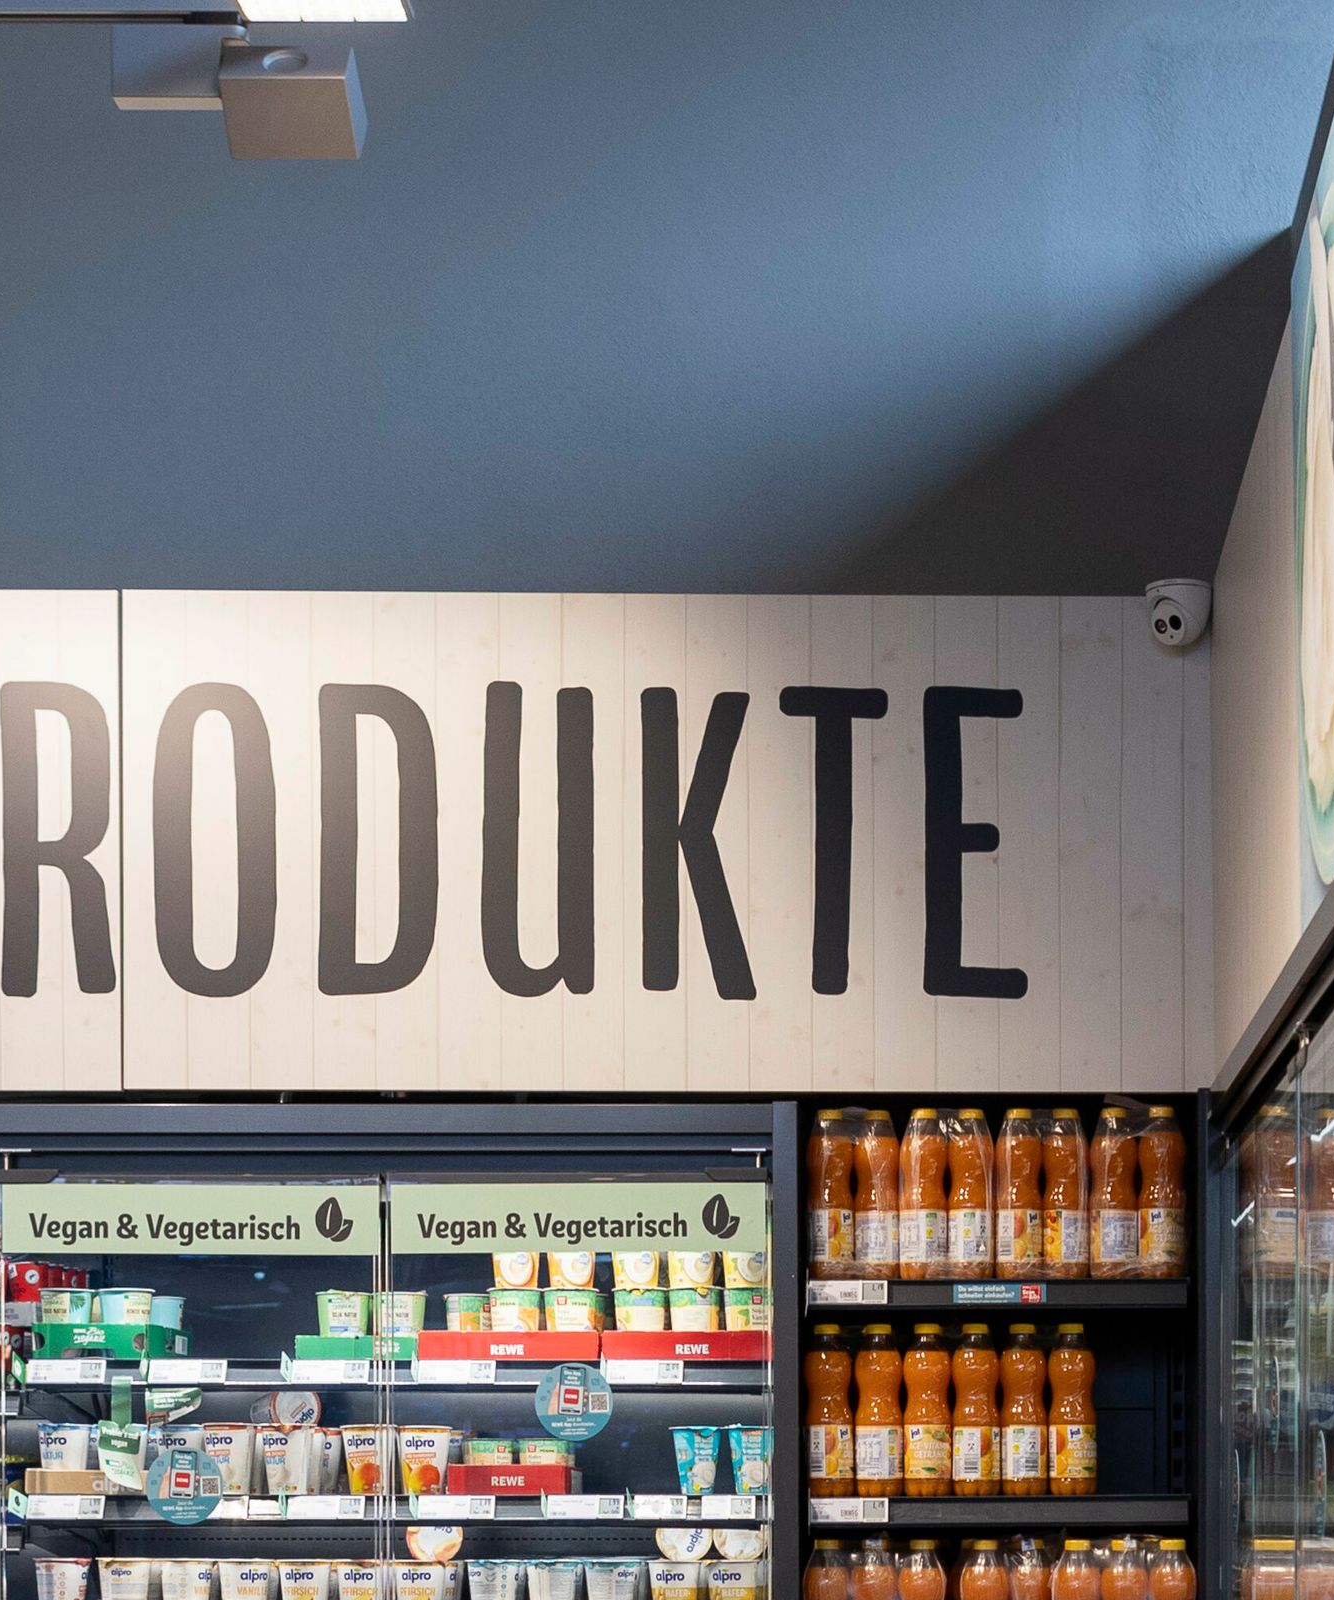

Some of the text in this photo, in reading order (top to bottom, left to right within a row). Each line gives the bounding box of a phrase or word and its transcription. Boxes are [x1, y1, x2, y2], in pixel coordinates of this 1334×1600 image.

[29, 1212, 300, 1243] Vegan & Vegetarisch
[417, 1210, 688, 1242] Vegan & Vegetarisch
[490, 1344, 524, 1355] REWE
[675, 1344, 709, 1355] REWE
[911, 1428, 921, 1438] ja!
[1069, 1428, 1080, 1438] ja!
[405, 1436, 435, 1450] alpro
[491, 1476, 525, 1487] REWE
[285, 1569, 314, 1583] alpro
[285, 1570, 314, 1583] alpro
[344, 1570, 373, 1583] alpro
[402, 1570, 431, 1583] alpro
[656, 1570, 685, 1583] alpro
[712, 1570, 741, 1583] alpro
